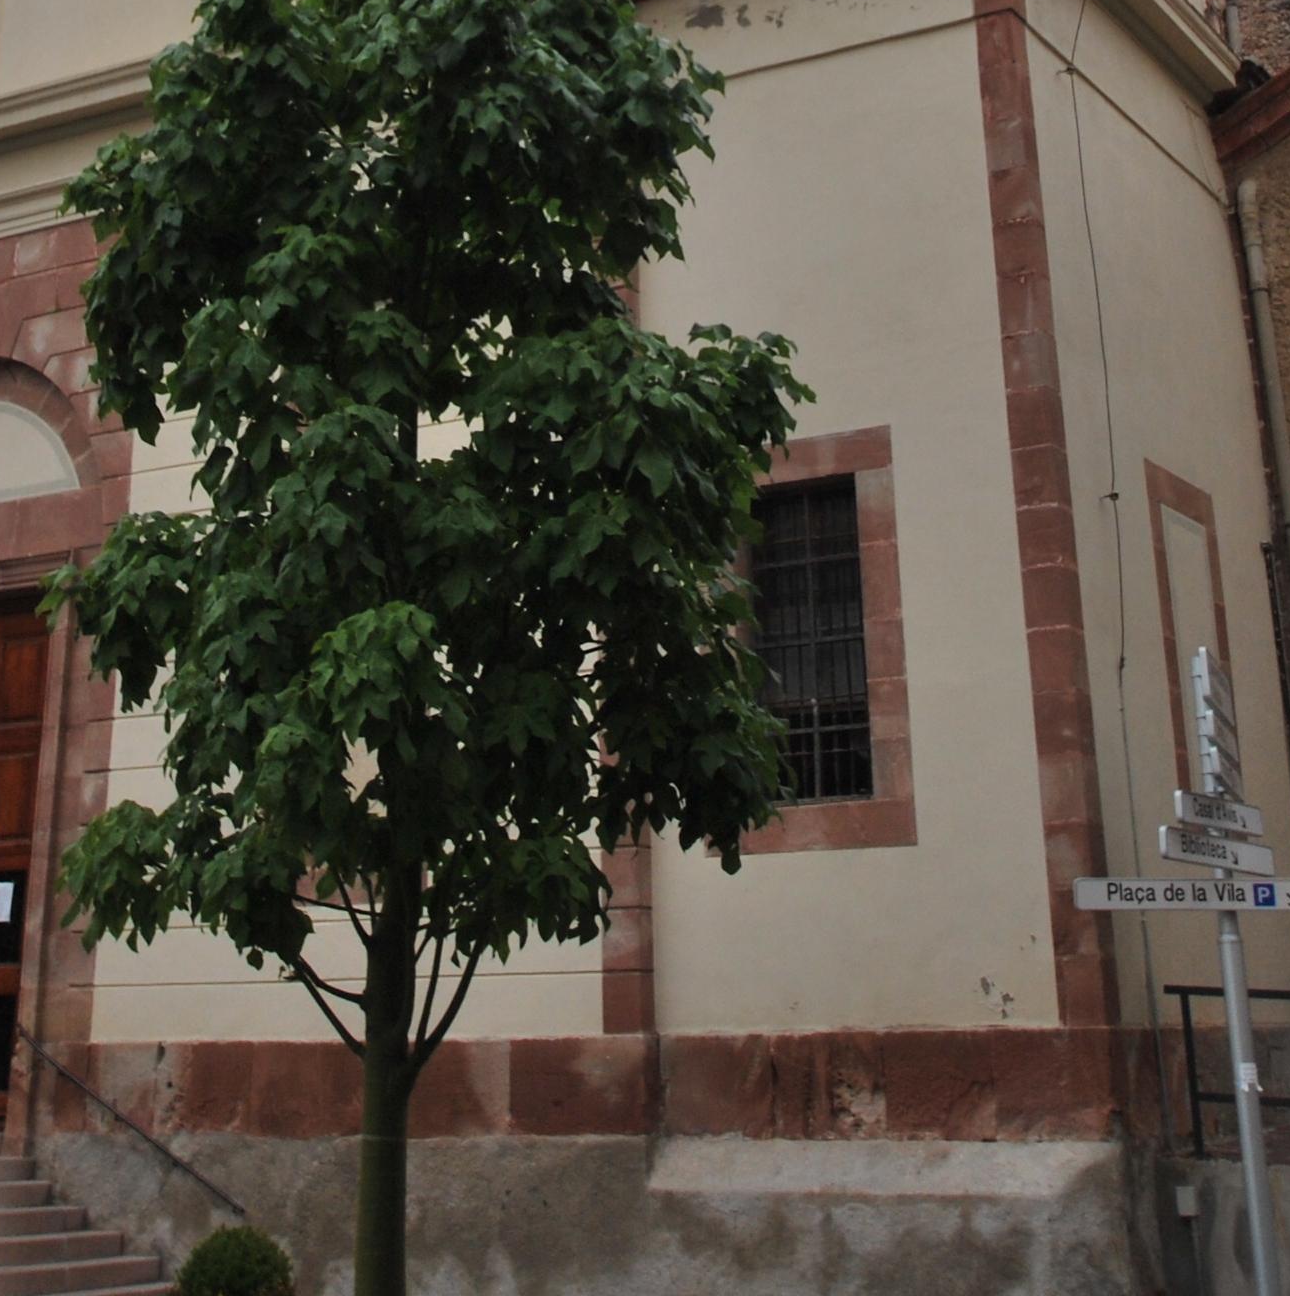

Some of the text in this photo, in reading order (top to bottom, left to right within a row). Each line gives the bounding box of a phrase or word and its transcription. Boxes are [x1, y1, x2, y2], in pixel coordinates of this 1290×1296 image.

[1180, 833, 1227, 860] Biblioteca
[1107, 882, 1156, 904] Plaça
[1163, 882, 1186, 902] de
[1191, 882, 1207, 902] la
[1214, 882, 1246, 902] Vila
